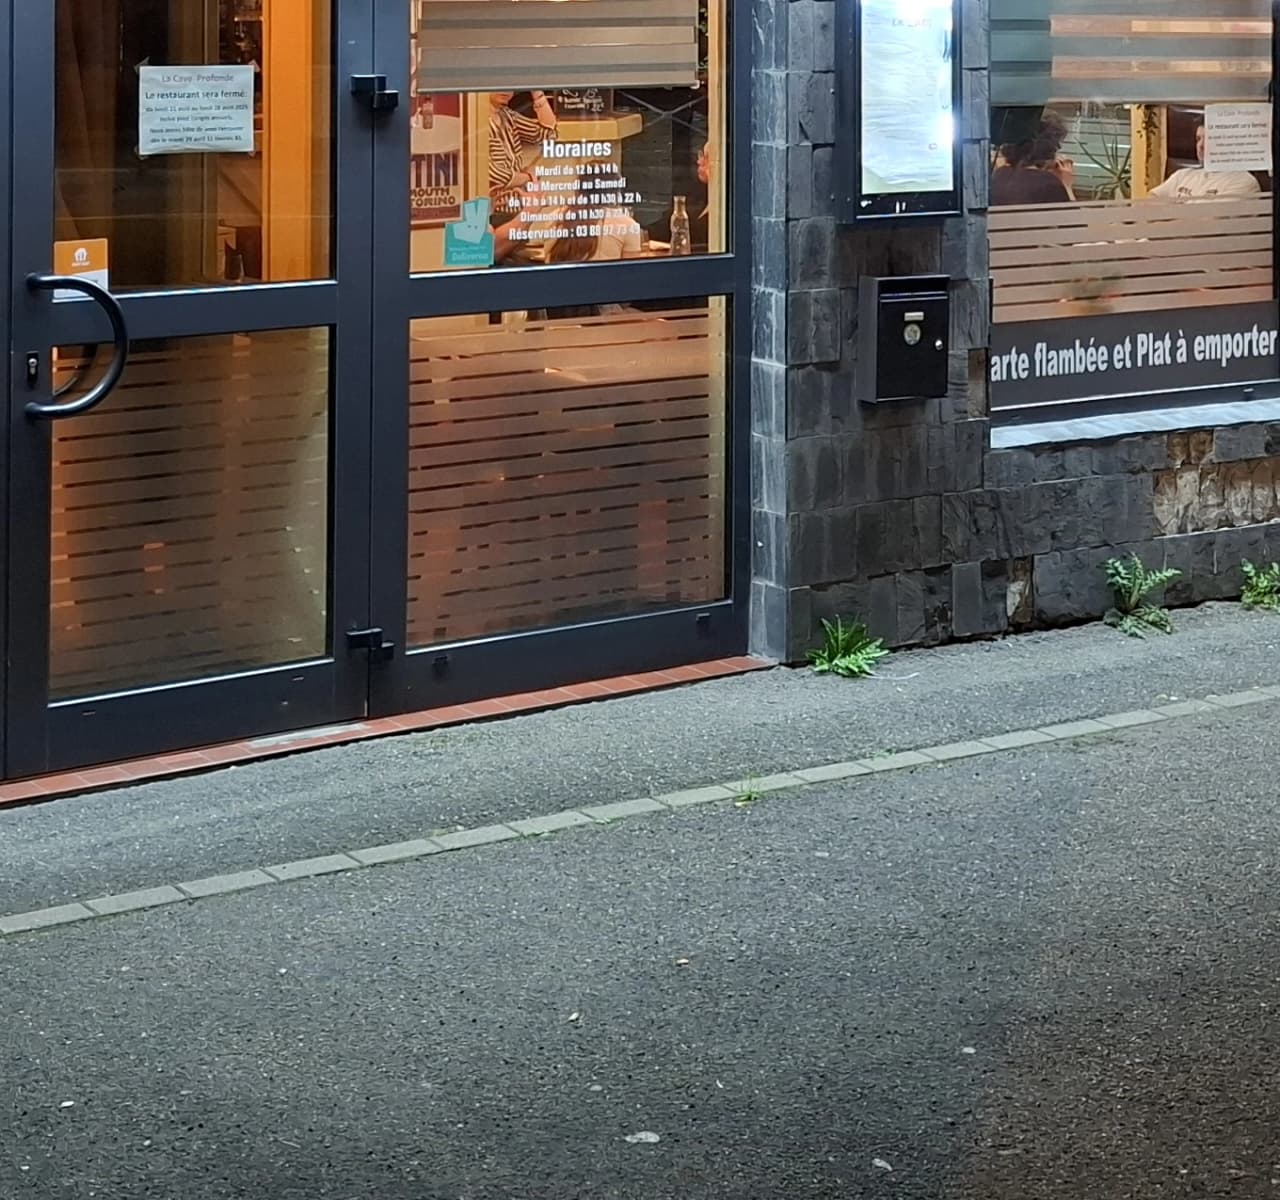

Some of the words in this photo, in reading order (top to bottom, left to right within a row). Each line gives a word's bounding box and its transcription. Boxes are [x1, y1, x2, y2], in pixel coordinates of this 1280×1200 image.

[157, 91, 200, 99] restaurant
[543, 139, 611, 158] Horaires
[535, 165, 561, 176] Mardi
[576, 165, 586, 175] 12
[587, 164, 593, 174] h
[601, 163, 611, 174] 14
[613, 163, 618, 173] h
[541, 180, 580, 191] Mercredi
[594, 177, 626, 189] Samedi
[624, 193, 634, 203] 22
[636, 192, 641, 203] h
[509, 226, 569, 240] Réservation
[576, 225, 588, 237] 03
[991, 345, 1029, 382] arte
[1034, 337, 1108, 377] flambée
[1113, 335, 1132, 369] et
[1137, 331, 1172, 367] Plat
[1176, 329, 1187, 363] à
[1193, 324, 1278, 367] emporter
